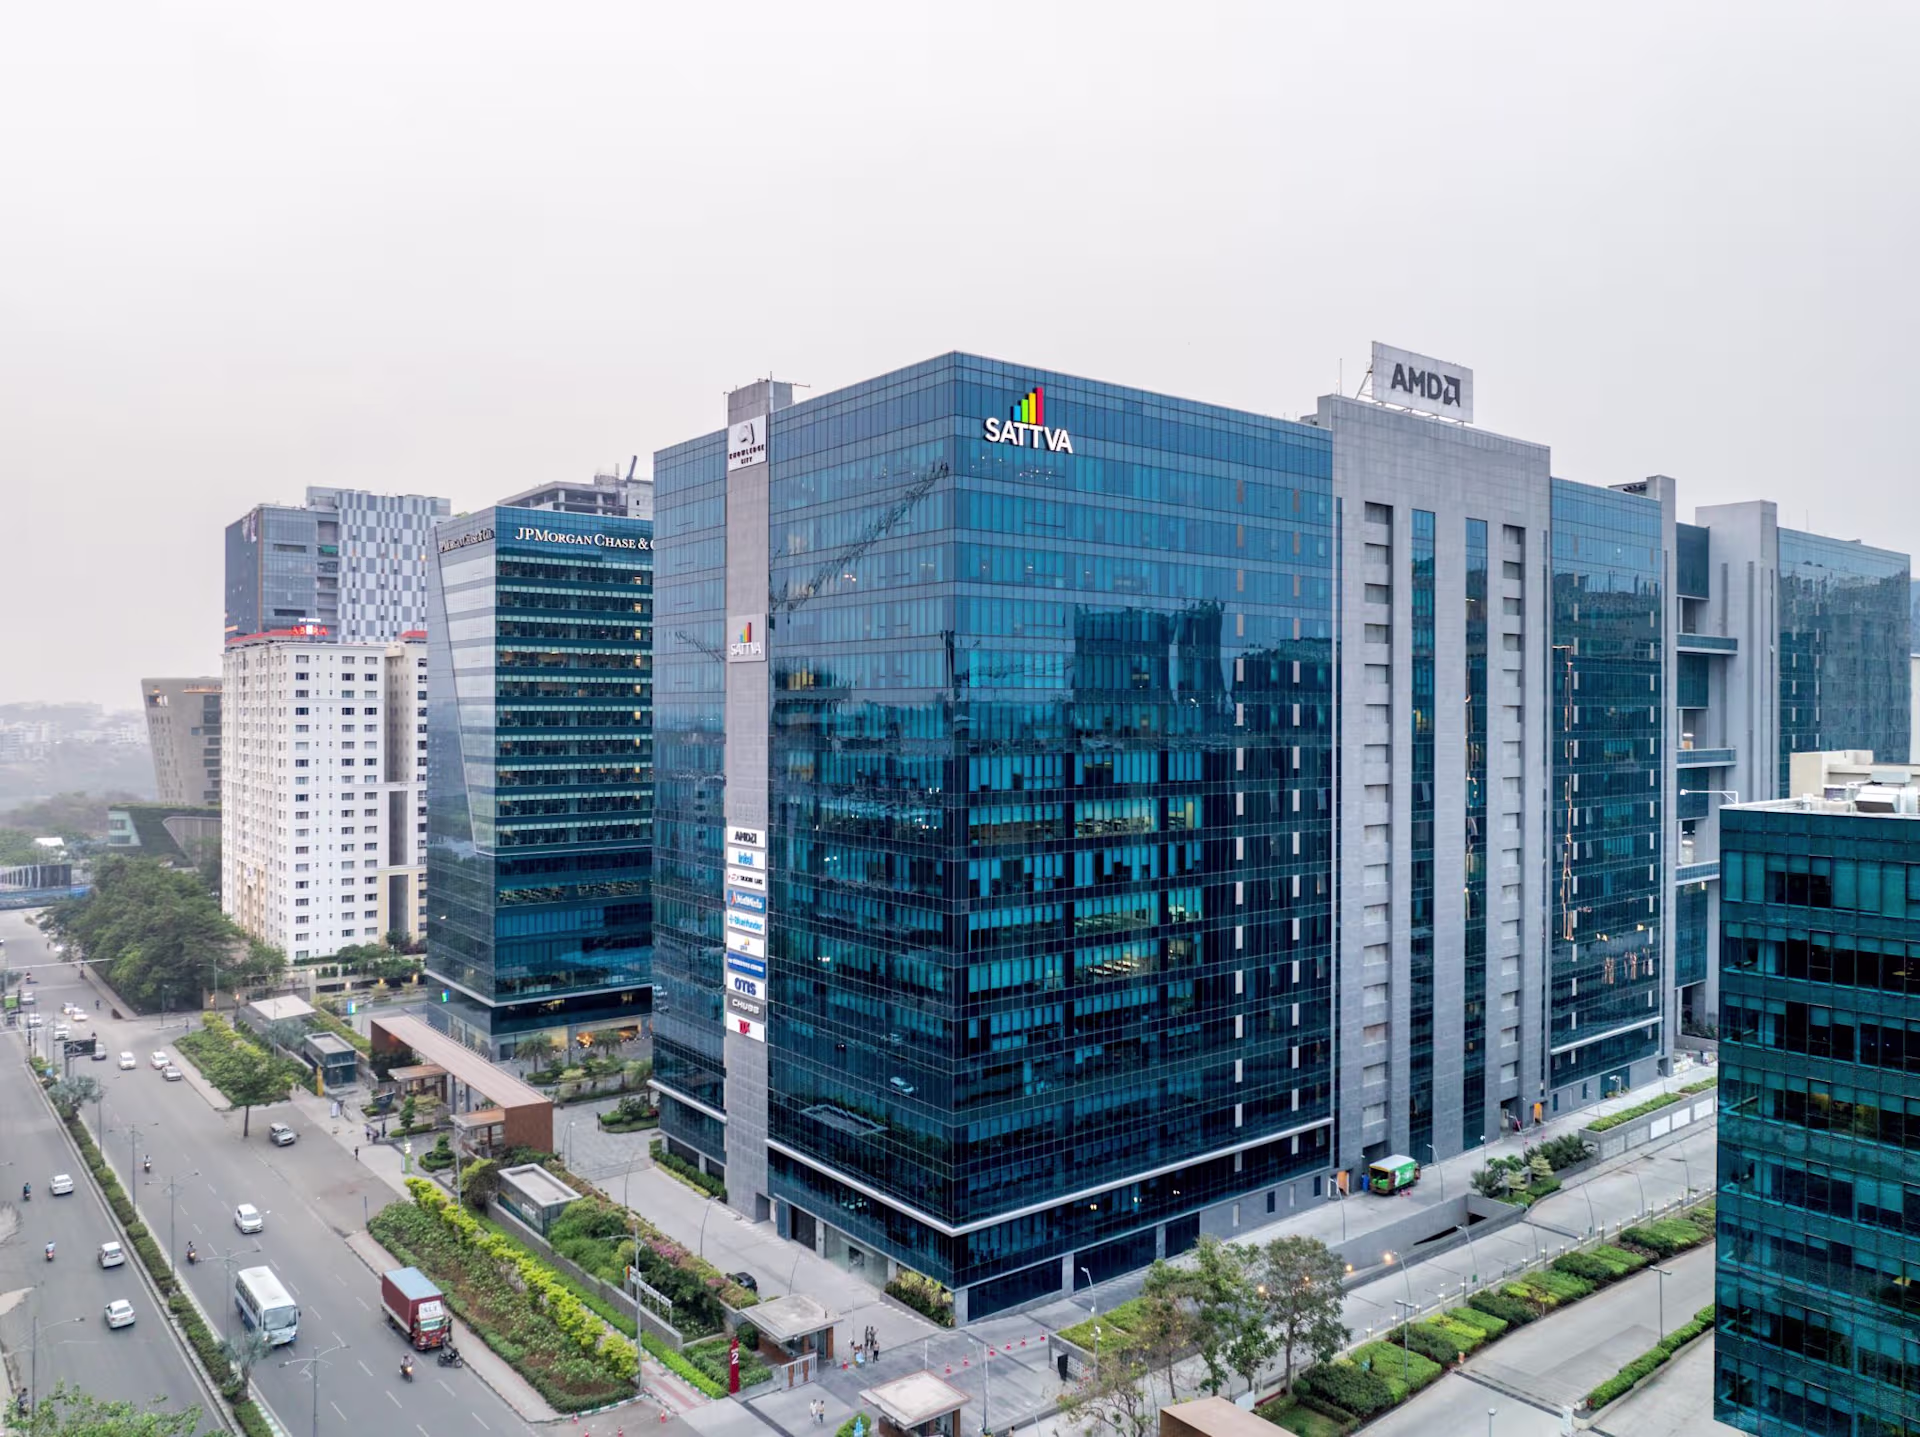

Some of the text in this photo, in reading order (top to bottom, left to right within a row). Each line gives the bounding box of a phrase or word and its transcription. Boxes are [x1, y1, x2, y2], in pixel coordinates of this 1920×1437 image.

[1390, 362, 1443, 401] AMD
[984, 417, 1074, 454] SATTVA
[740, 456, 753, 465] CITY
[515, 527, 592, 545] JPMORGAN
[594, 533, 636, 549] CHASE
[638, 537, 650, 550] &
[734, 977, 757, 996] OTIS
[731, 1352, 739, 1365] 2
